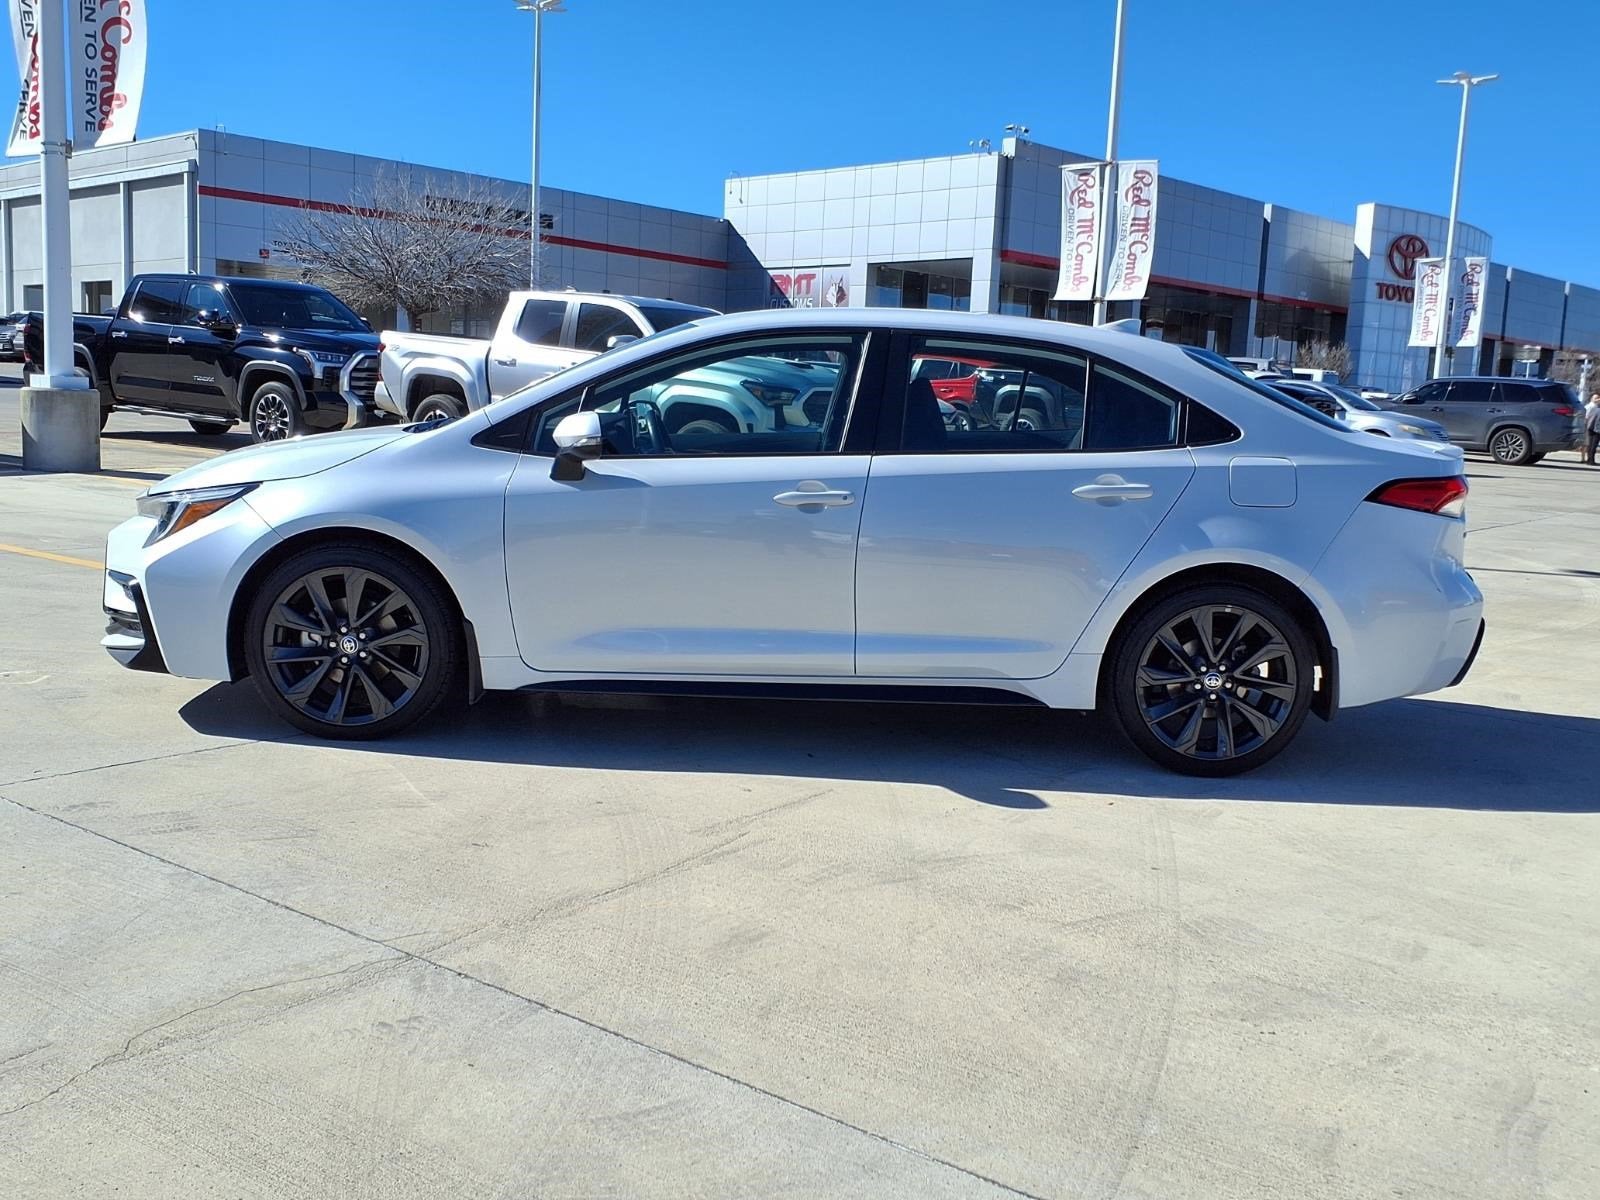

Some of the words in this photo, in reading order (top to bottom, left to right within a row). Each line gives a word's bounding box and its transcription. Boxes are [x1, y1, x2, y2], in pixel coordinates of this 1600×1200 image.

[85, 30, 97, 60] TO
[85, 68, 97, 132] SERVE
[1069, 172, 1096, 209] Red
[1125, 169, 1153, 207] Red
[1067, 208, 1075, 244] DRIVEN
[1066, 248, 1074, 261] TO
[1376, 282, 1415, 304] TOYO
